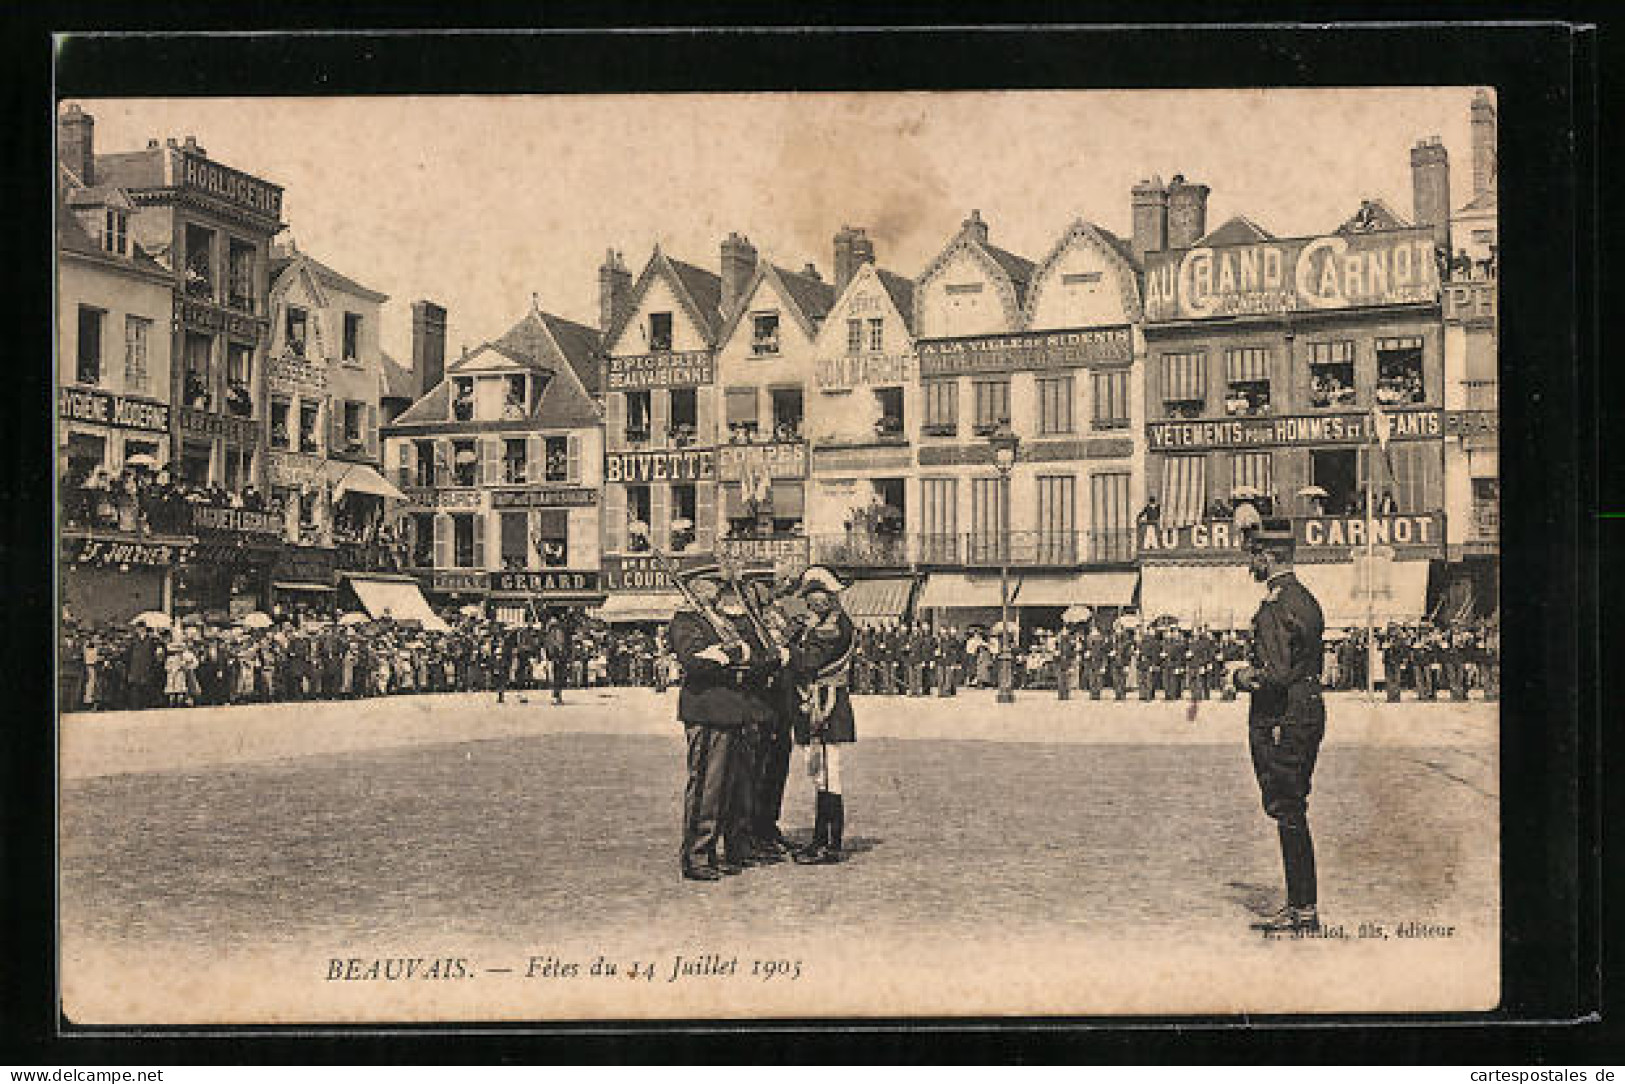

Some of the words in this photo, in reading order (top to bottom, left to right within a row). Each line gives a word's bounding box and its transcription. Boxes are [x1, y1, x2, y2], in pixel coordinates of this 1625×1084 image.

[1146, 263, 1174, 320] AU
[1180, 248, 1281, 317] GRAND
[1296, 238, 1436, 307] CARNOT
[1274, 417, 1344, 440] HOMMES
[607, 451, 714, 481] BUVETTE
[1144, 524, 1178, 550] AU
[1305, 516, 1432, 544] CARNOT
